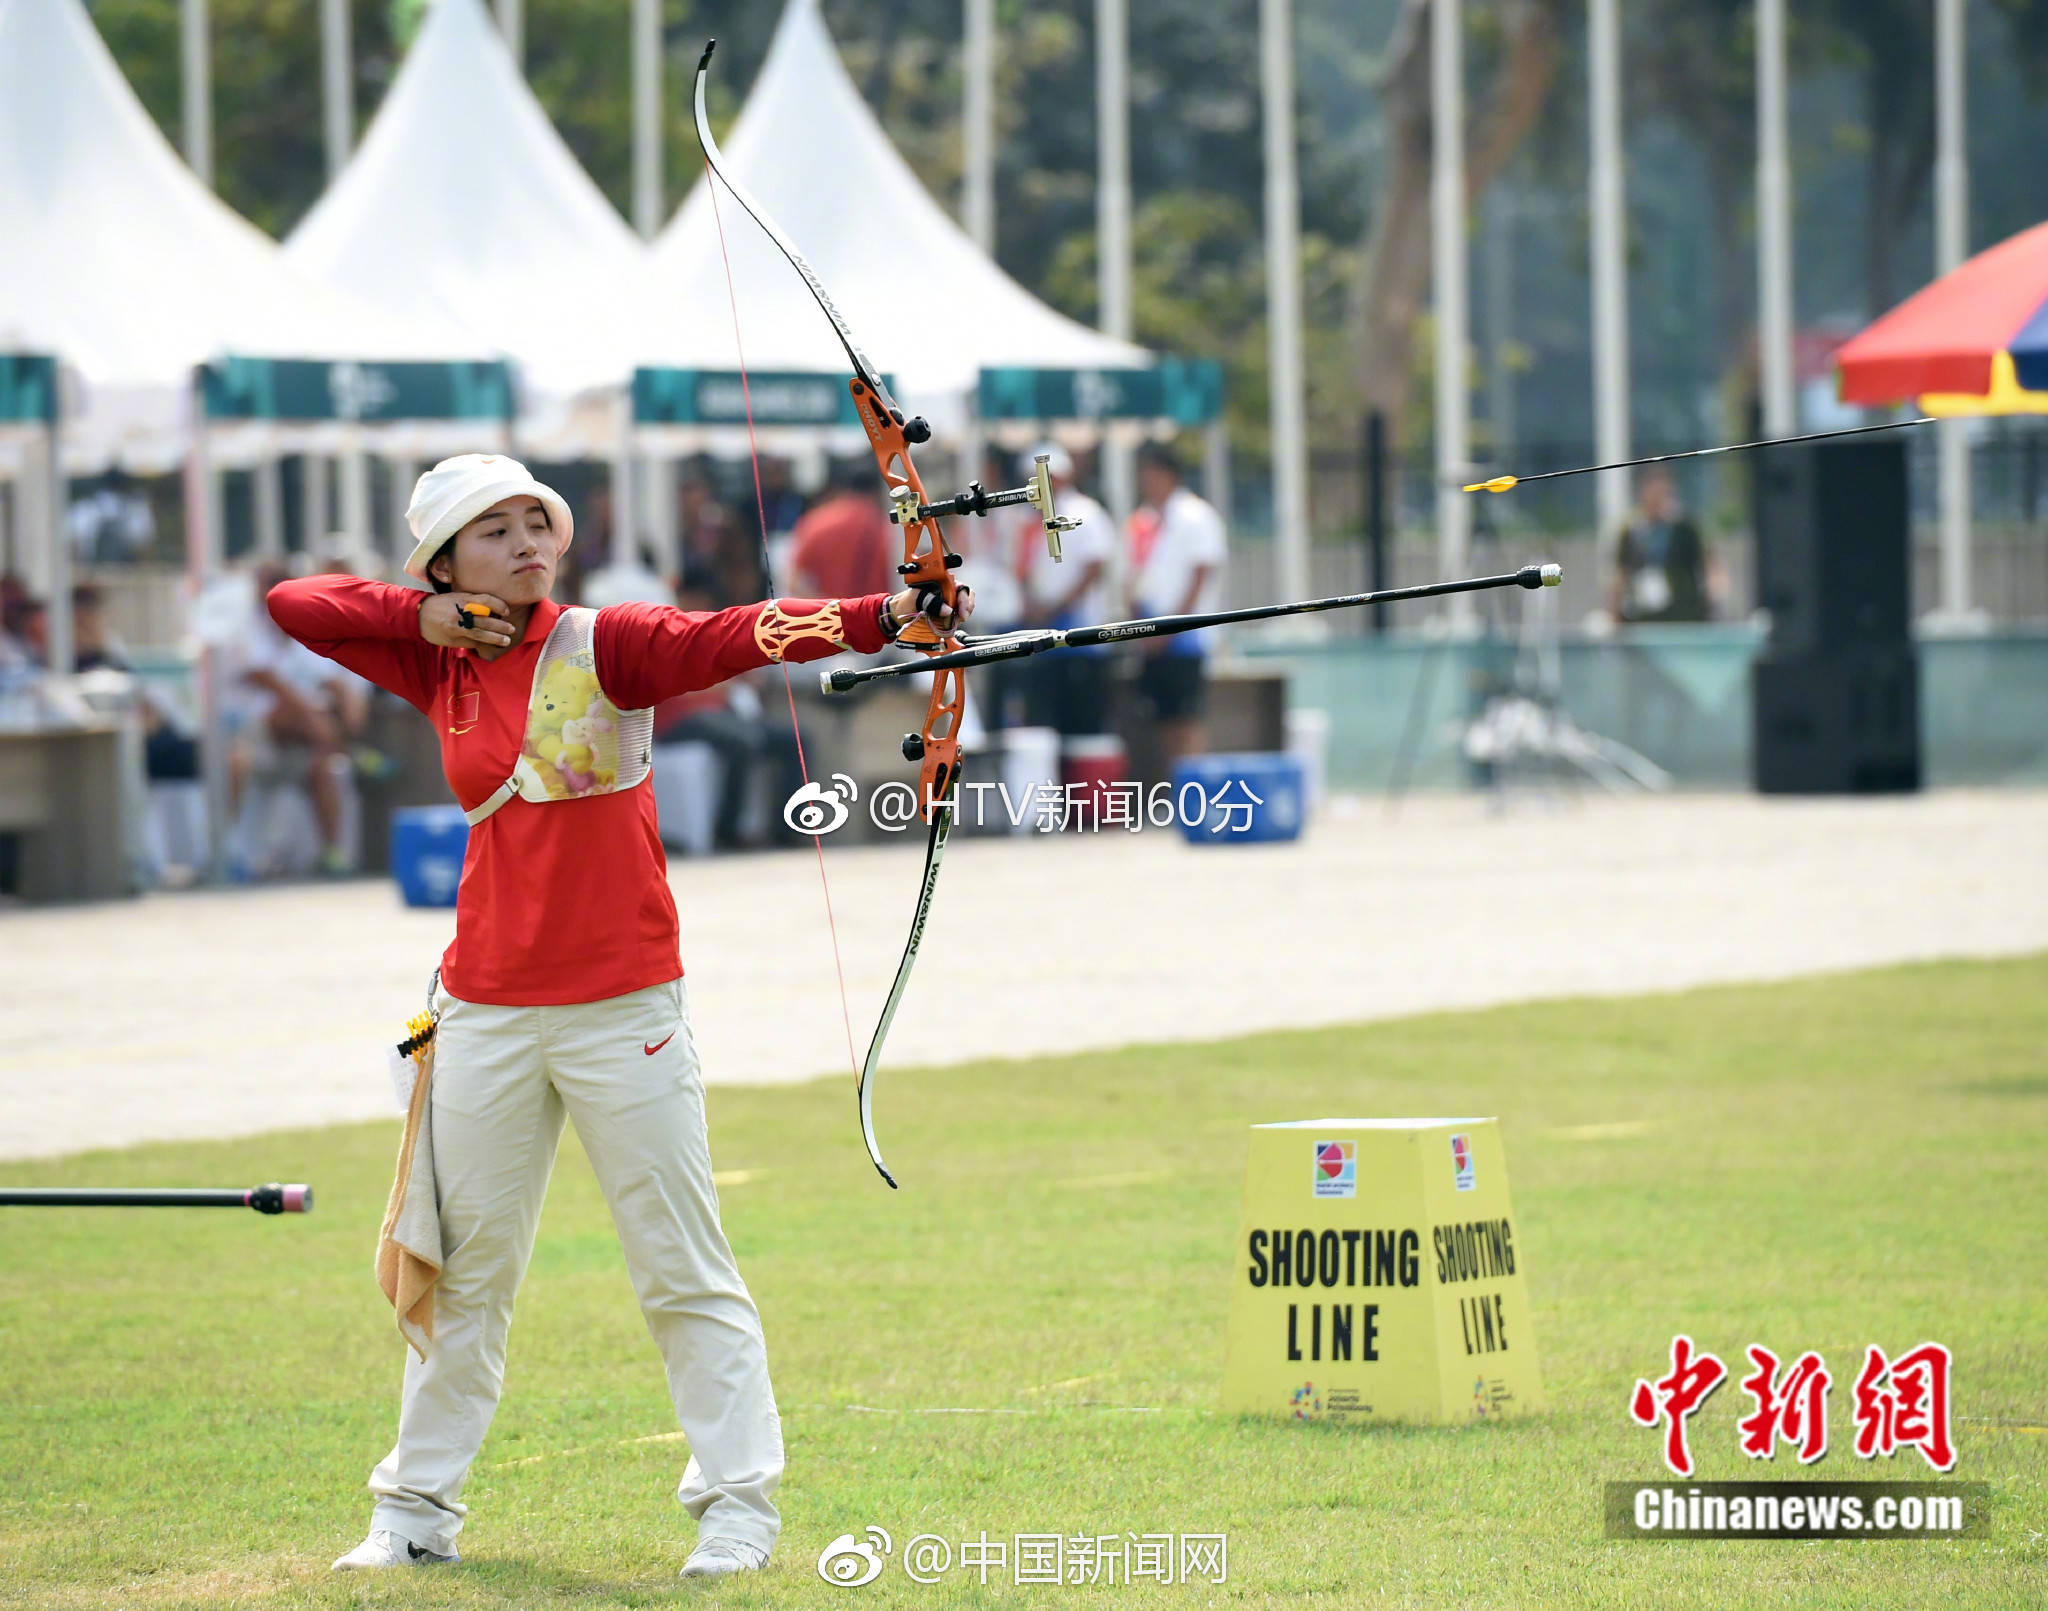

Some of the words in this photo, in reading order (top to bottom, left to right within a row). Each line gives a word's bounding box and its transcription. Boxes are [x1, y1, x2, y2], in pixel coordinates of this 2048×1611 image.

[997, 492, 1028, 503] SHIBUYA
[986, 642, 1020, 655] EASTON
[1113, 624, 1156, 637] EASTON
[908, 862, 940, 956] WIN&WIN
[1249, 1229, 1419, 1288] SHOOTING
[1433, 1217, 1516, 1285] SHOOTING
[1287, 1304, 1380, 1361] LINE
[1460, 1293, 1508, 1356] LINE
